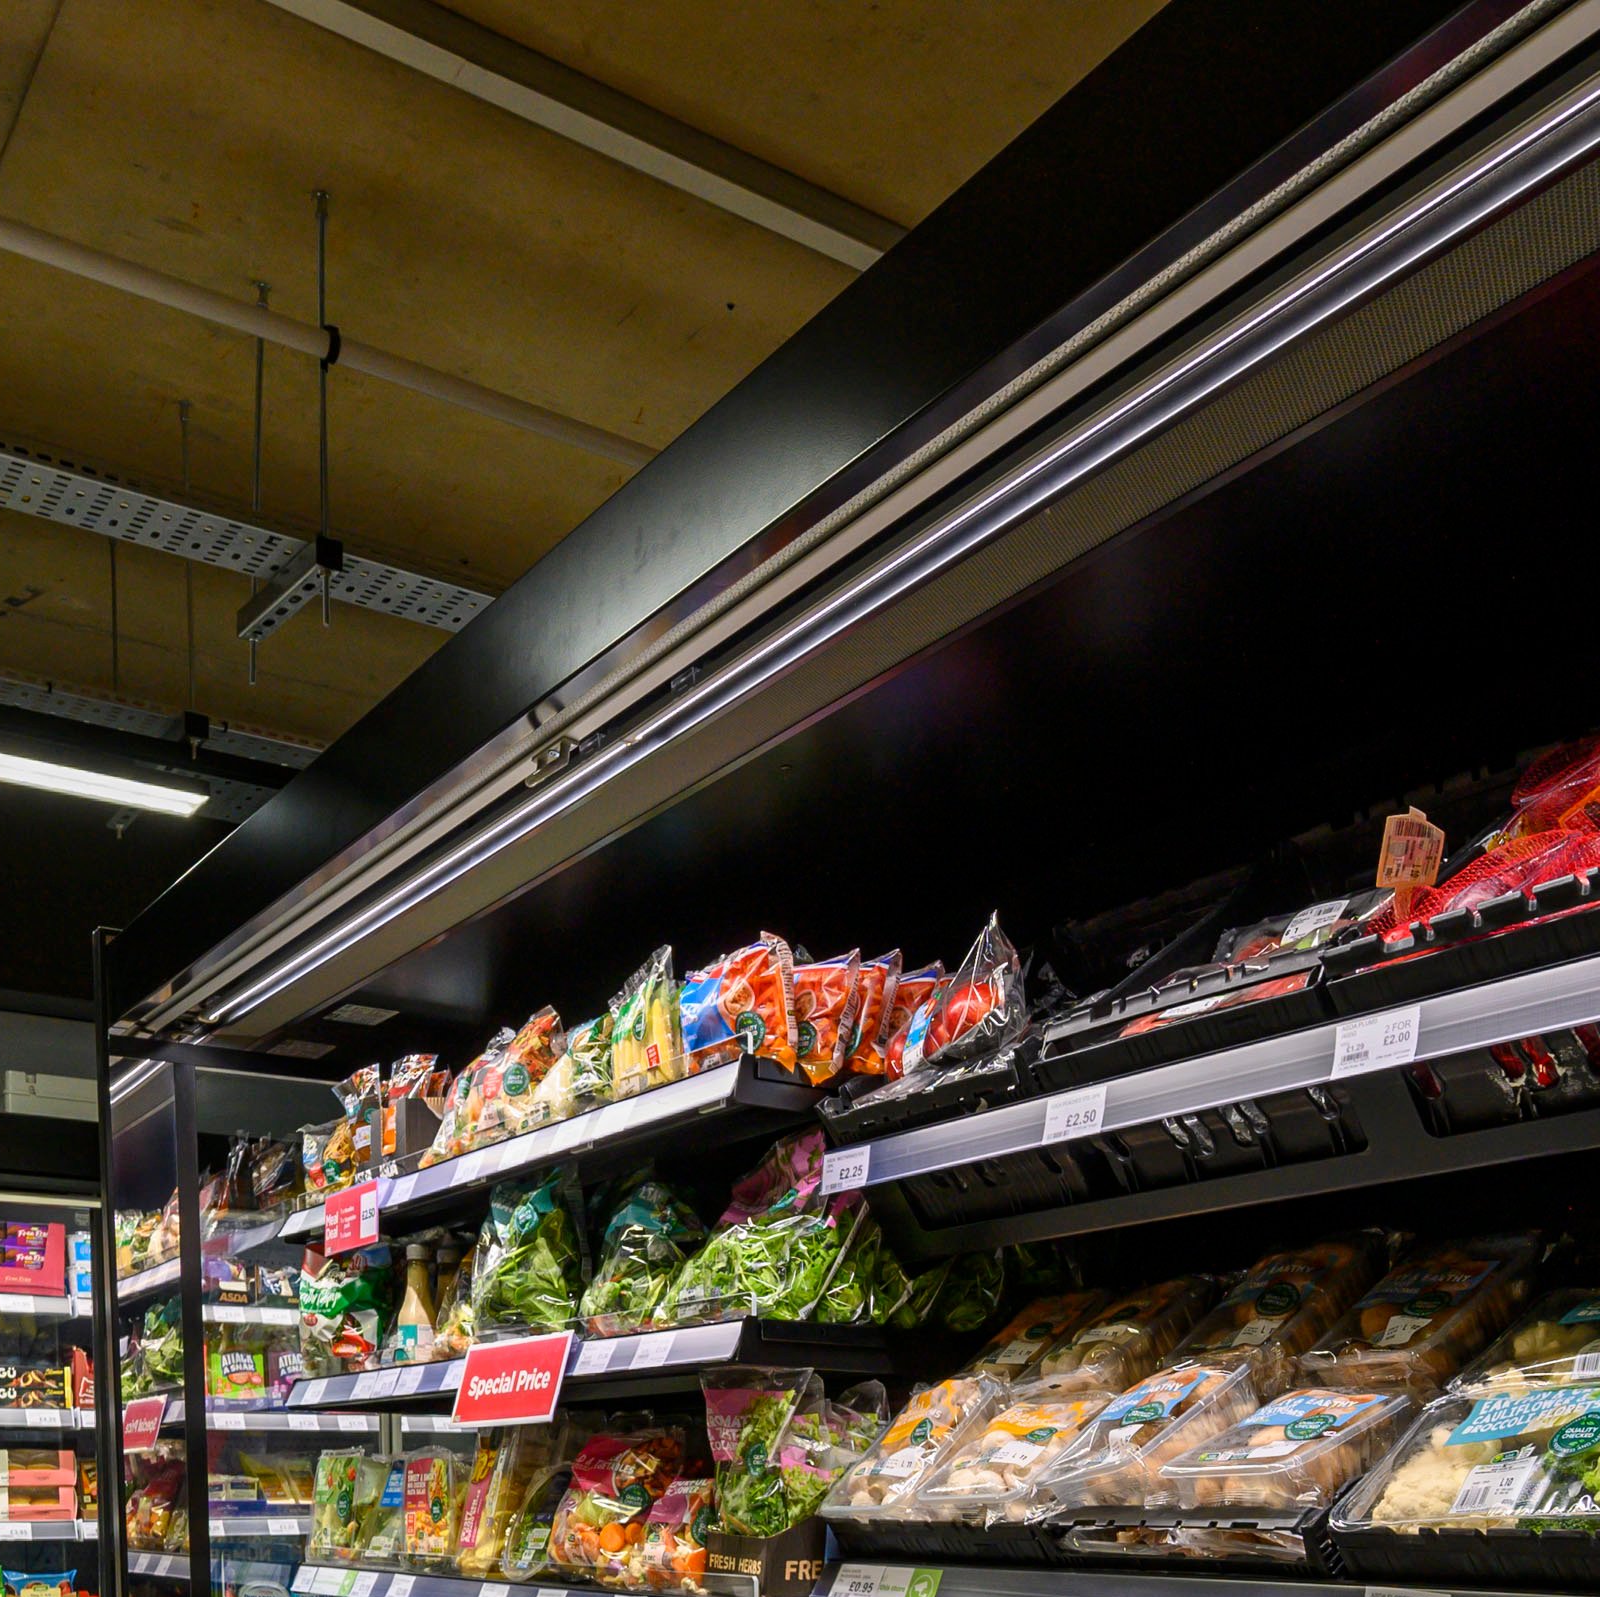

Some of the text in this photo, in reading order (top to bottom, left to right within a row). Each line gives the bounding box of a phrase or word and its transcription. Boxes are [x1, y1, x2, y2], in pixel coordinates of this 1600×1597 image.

[1384, 1020, 1411, 1033] 2 FOR
[1383, 1031, 1410, 1046] £2.00
[1066, 1109, 1097, 1128] £2.50
[839, 1165, 863, 1180] £2.25
[325, 1212, 339, 1227] Meal
[325, 1225, 339, 1241] Deal
[219, 1292, 248, 1303] ASDA
[468, 1368, 550, 1400] Special Price
[1565, 1426, 1599, 1434] QUALITY
[709, 1553, 762, 1574] FRESH HERBS
[849, 1581, 875, 1593] £0.95
